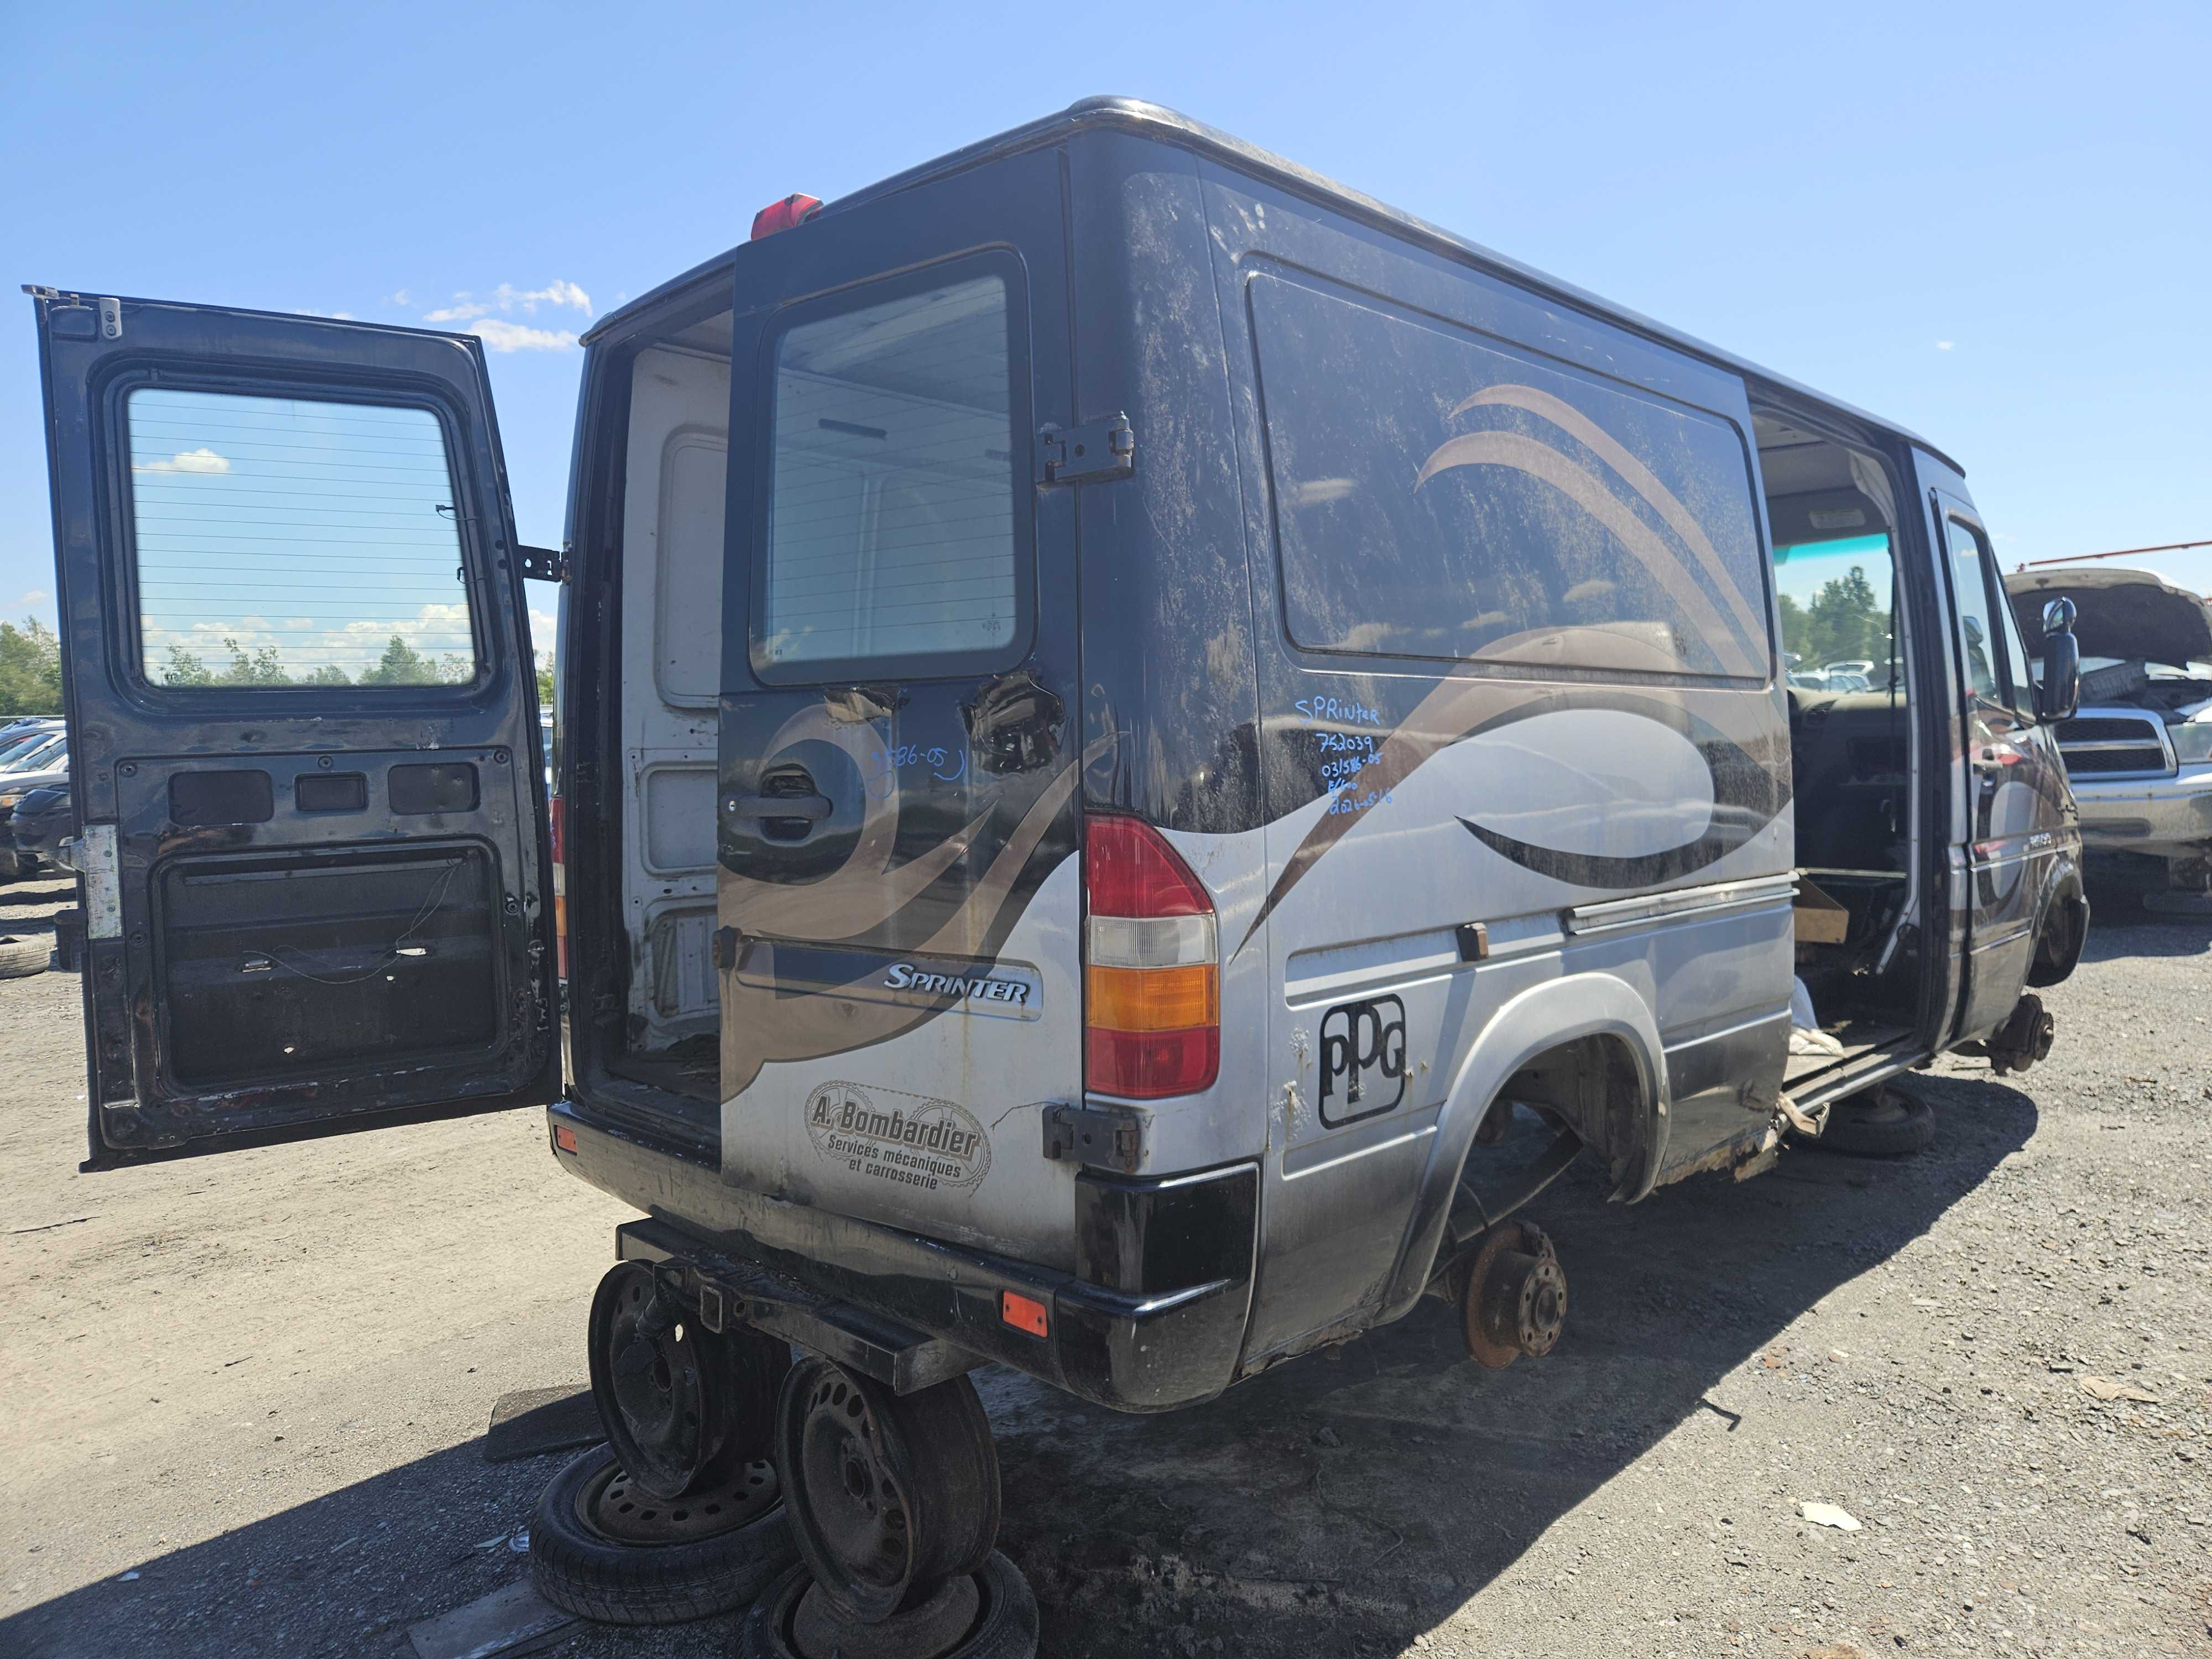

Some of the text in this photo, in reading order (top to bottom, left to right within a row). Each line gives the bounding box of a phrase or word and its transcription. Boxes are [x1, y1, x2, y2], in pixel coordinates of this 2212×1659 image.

[1315, 733, 1374, 753] 752039
[883, 963, 1031, 1004] SPRINTER
[811, 1094, 980, 1159] A. Bombardier
[828, 1134, 962, 1178] Services mécaniques
[849, 1159, 938, 1190] et carrosserie
